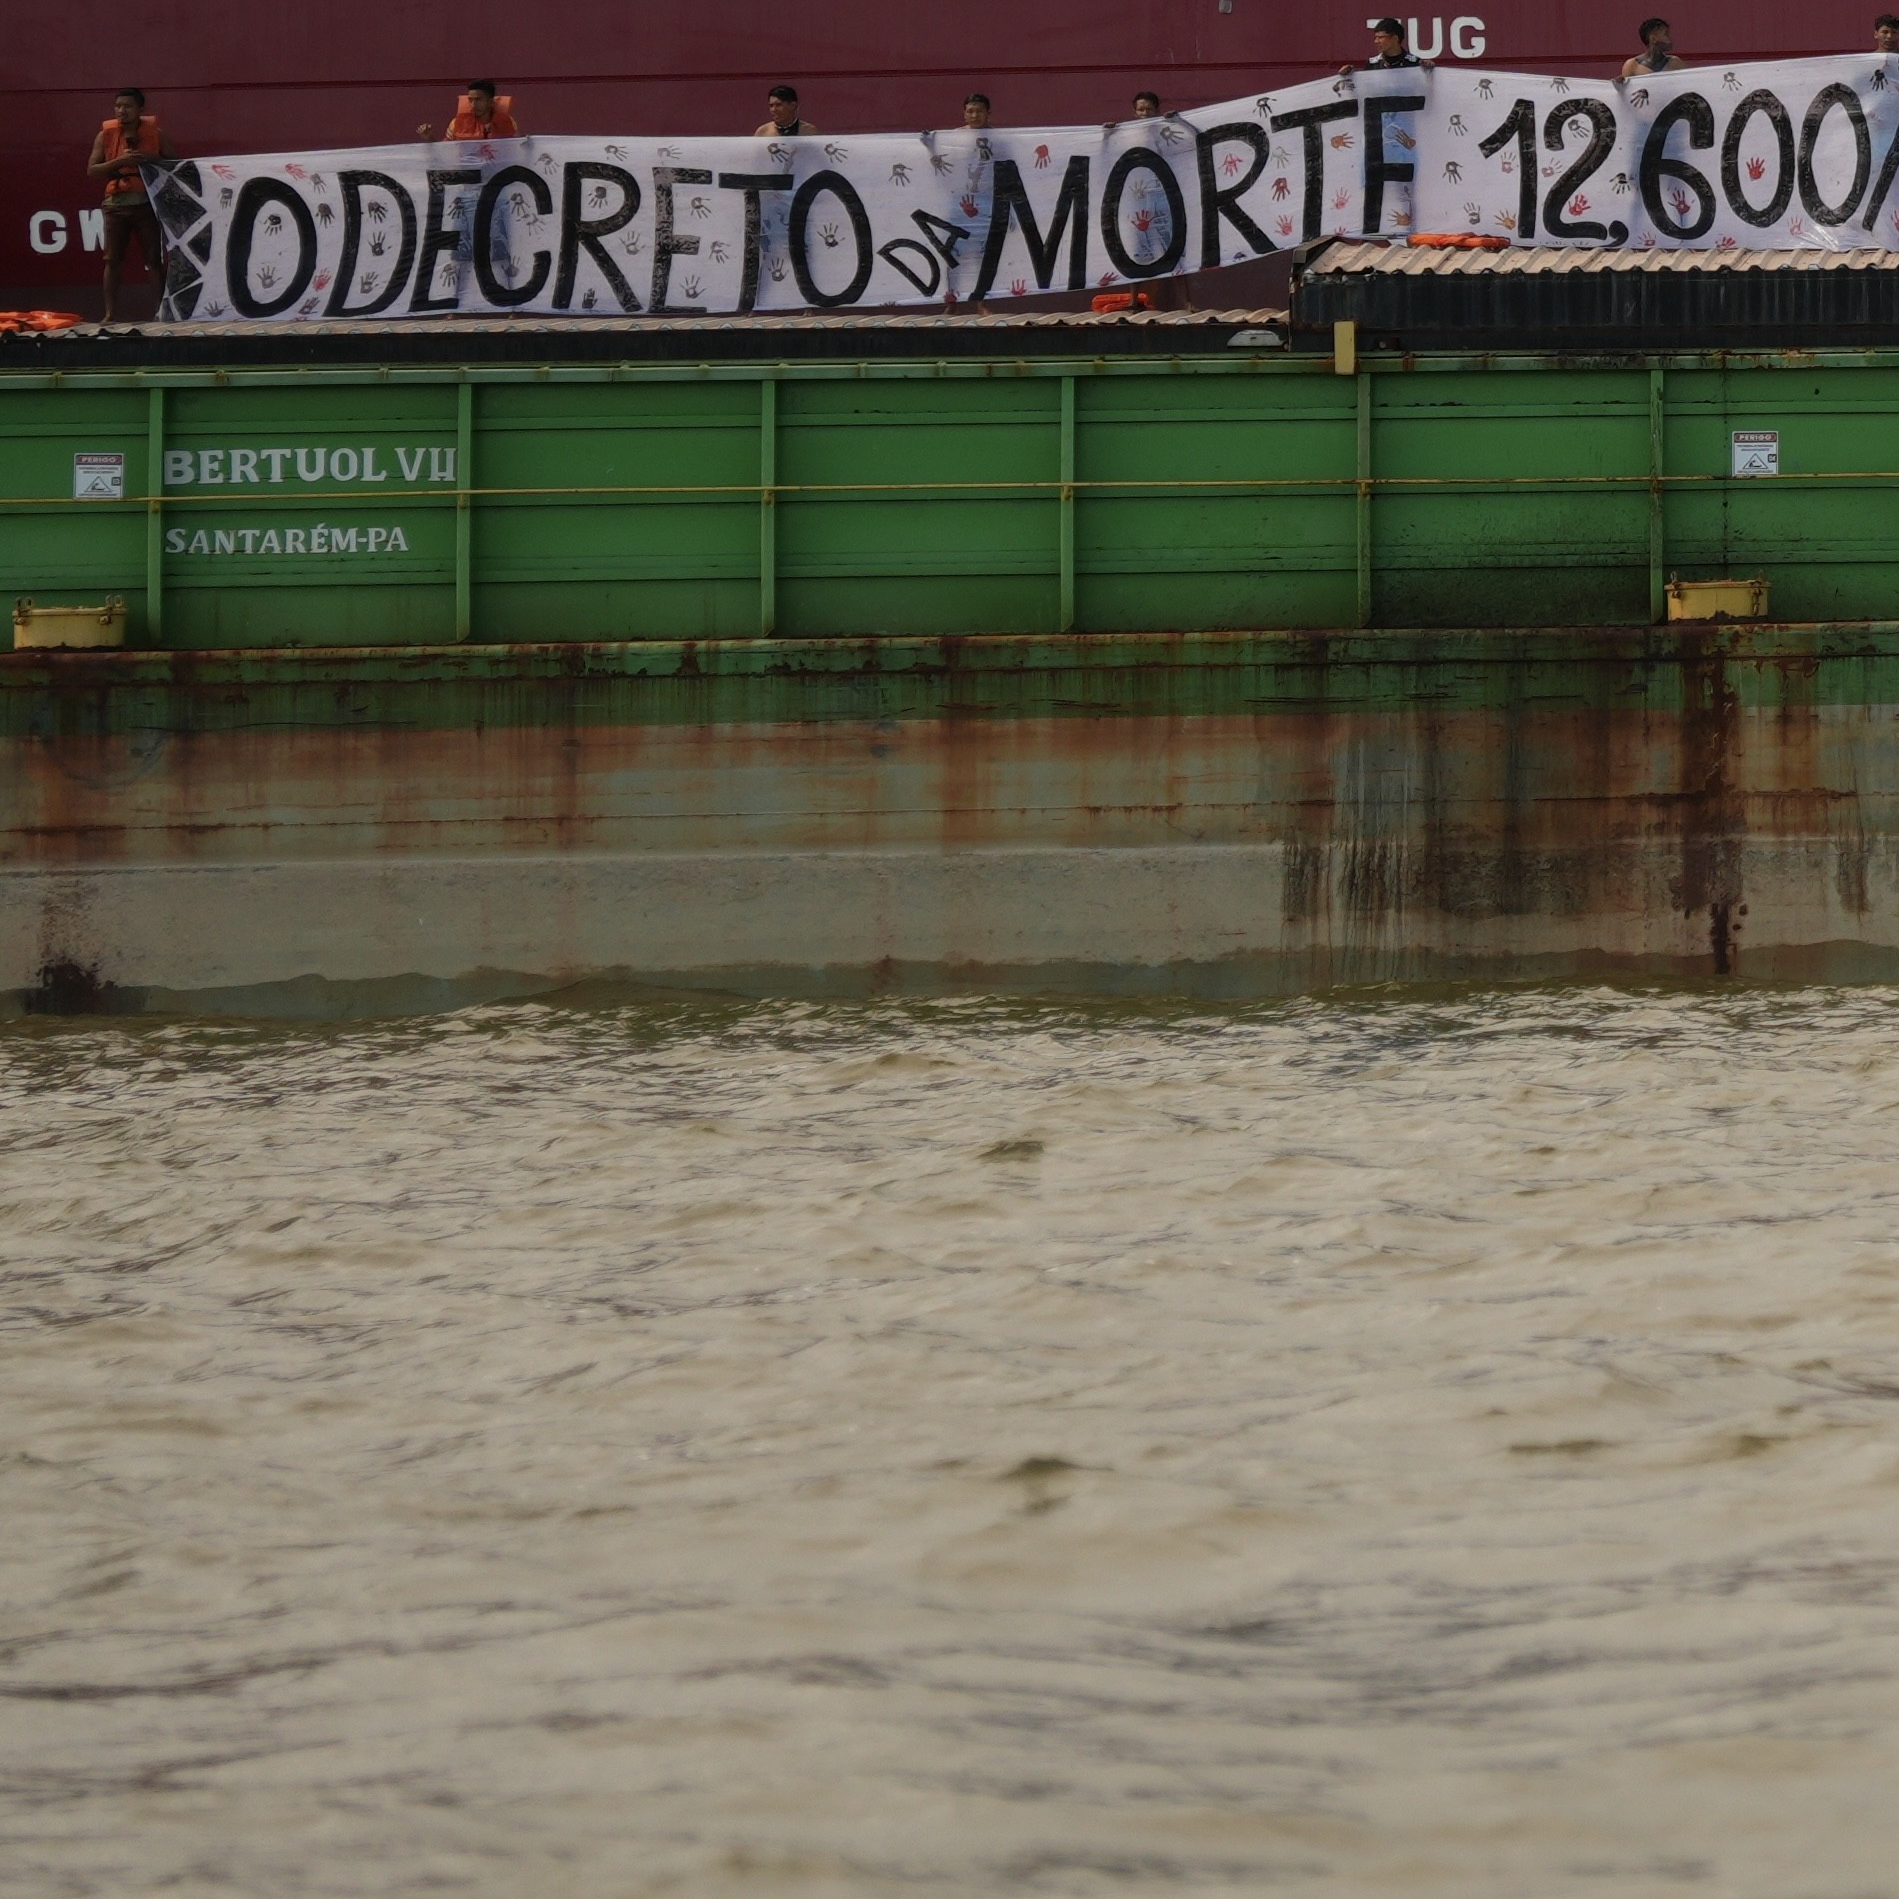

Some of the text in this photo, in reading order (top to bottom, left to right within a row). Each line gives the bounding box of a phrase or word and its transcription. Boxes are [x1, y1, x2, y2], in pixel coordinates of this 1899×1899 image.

[876, 208, 971, 298] DA
[163, 447, 387, 485] BERTUOL
[164, 522, 410, 556] SANTARÉM-PA
